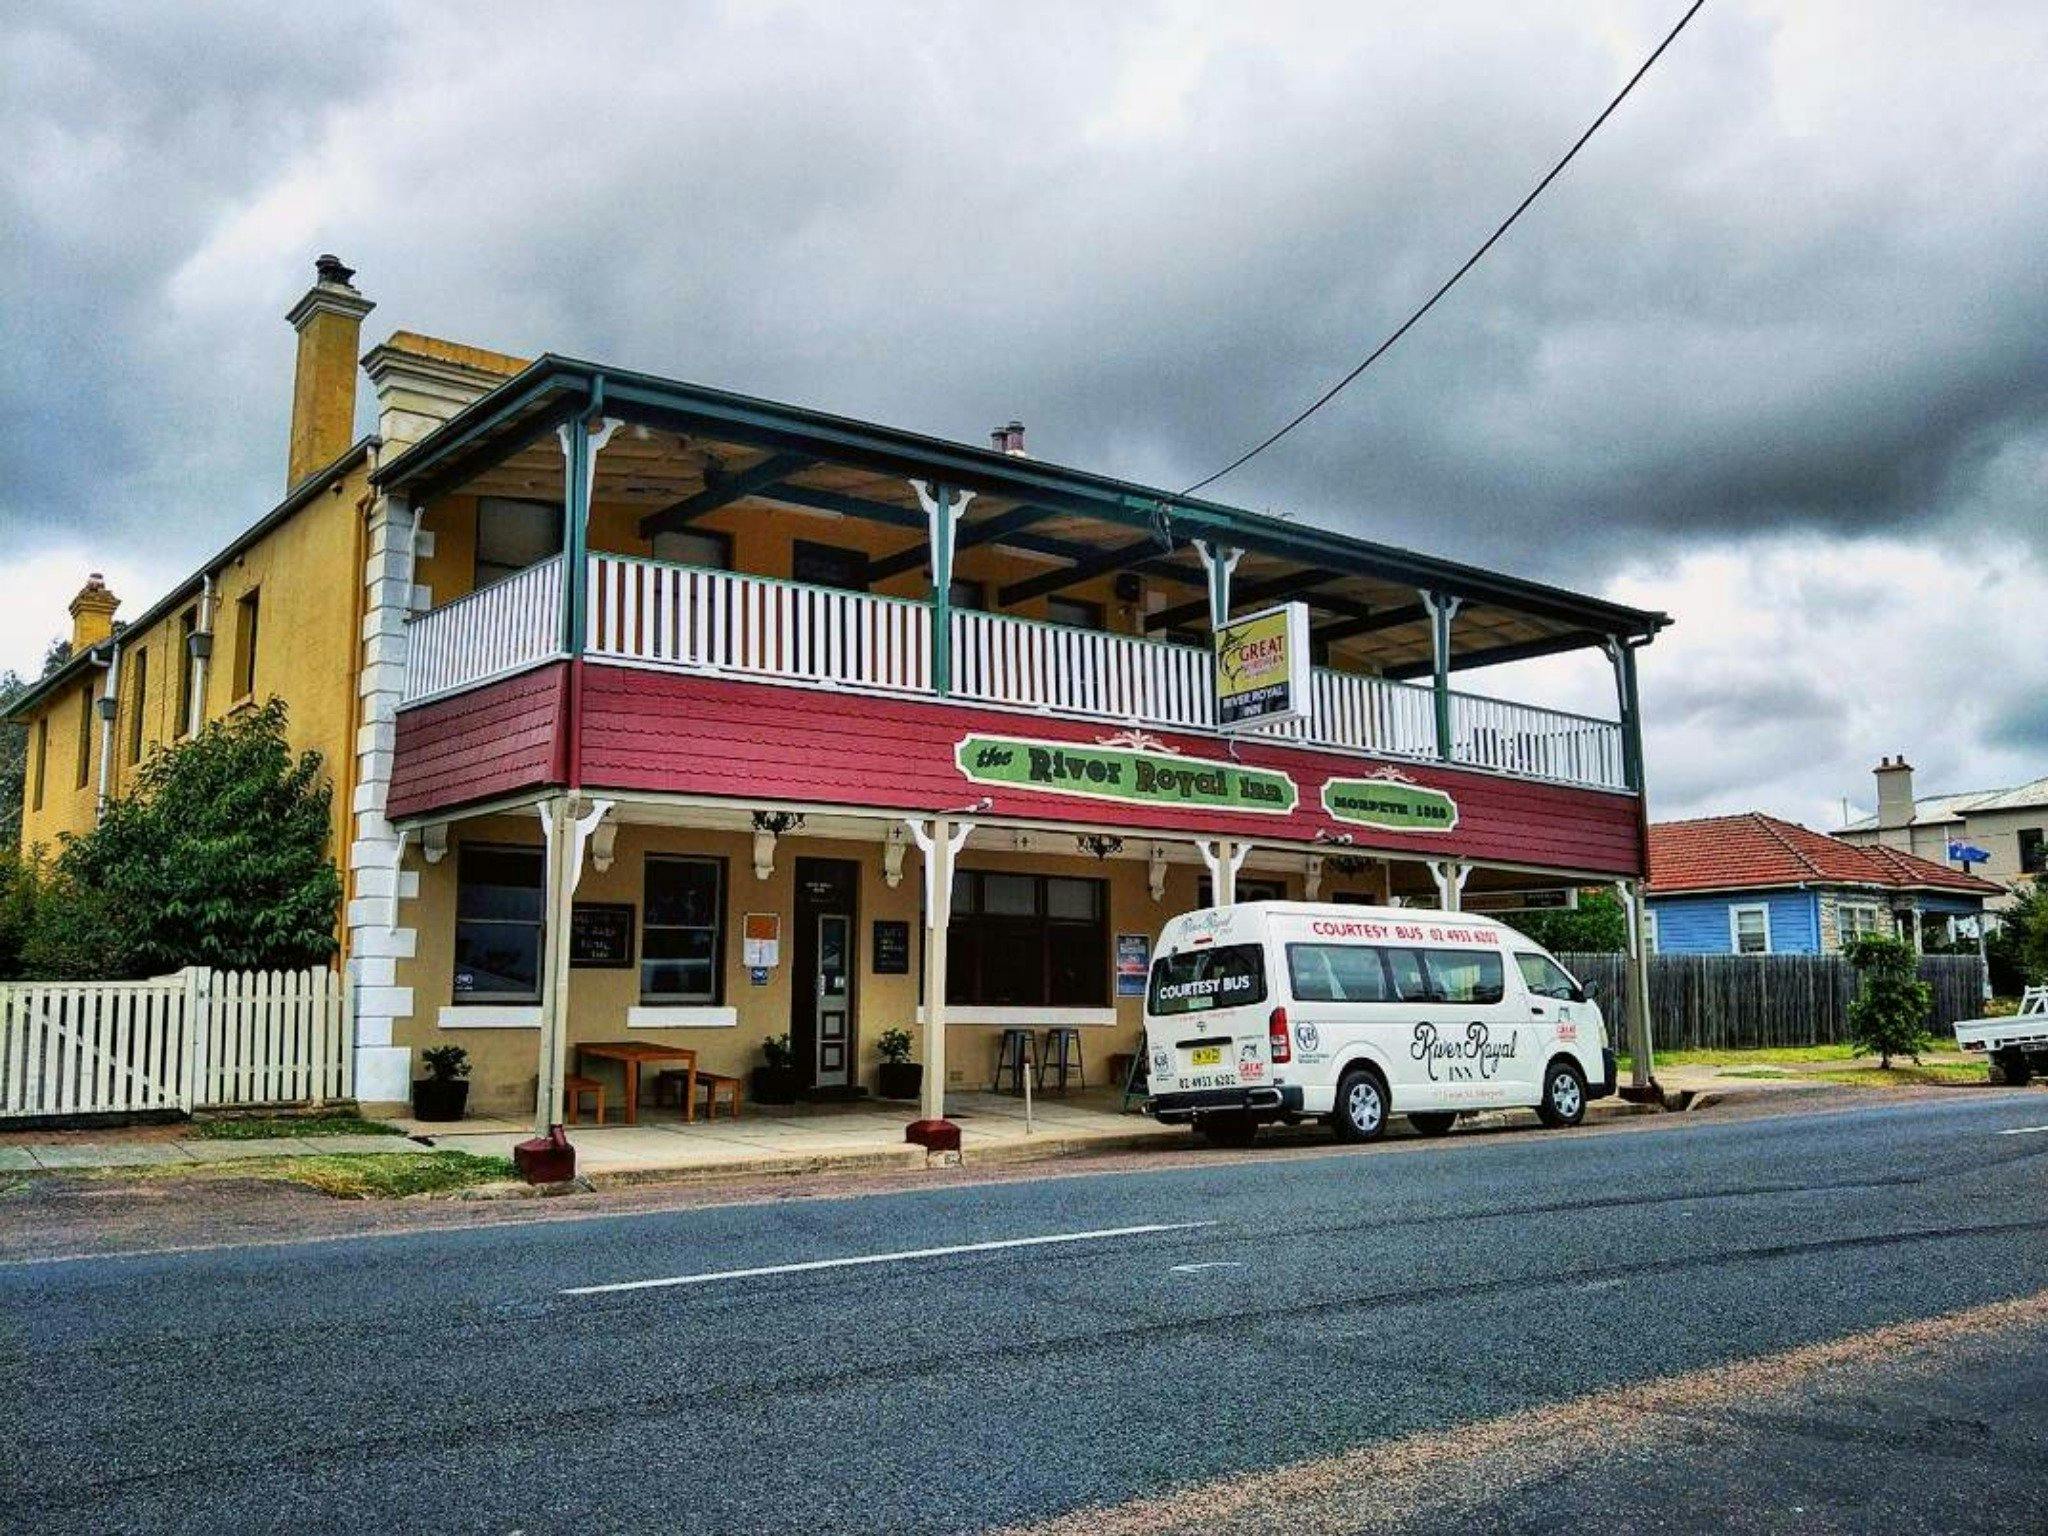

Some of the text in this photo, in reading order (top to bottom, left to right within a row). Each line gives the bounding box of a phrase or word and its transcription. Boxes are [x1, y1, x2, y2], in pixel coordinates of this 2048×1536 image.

[1240, 635, 1284, 662] GREAT
[1252, 686, 1284, 701] ROYAL
[976, 748, 1284, 803] the River Royal Inn
[1334, 796, 1408, 815] MORPETH
[1313, 921, 1389, 939] COURTESY
[1395, 925, 1424, 941] BUS
[1222, 975, 1250, 991] BUS
[1411, 1021, 1517, 1080] River Royal
